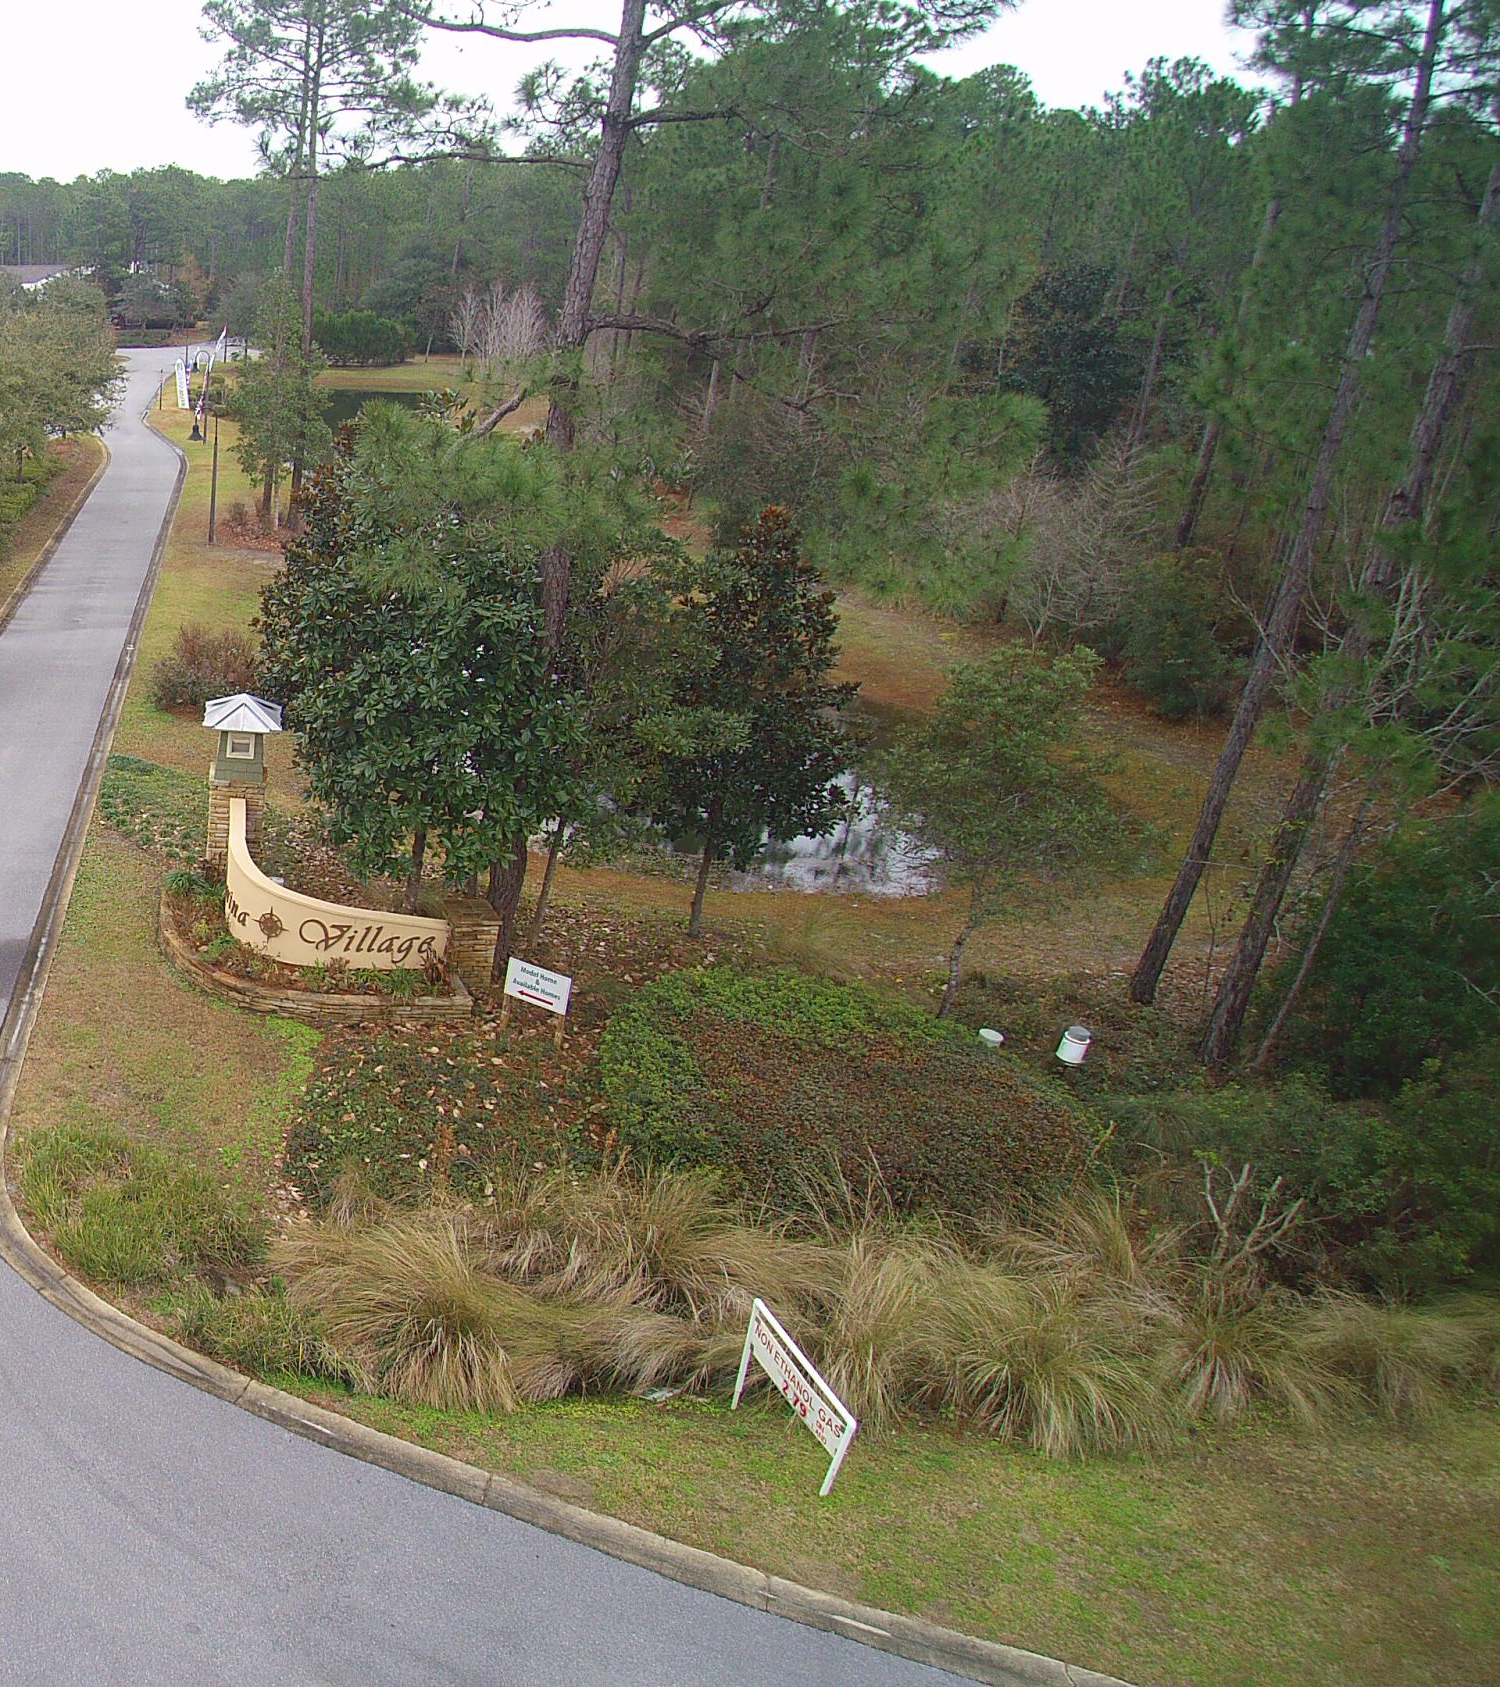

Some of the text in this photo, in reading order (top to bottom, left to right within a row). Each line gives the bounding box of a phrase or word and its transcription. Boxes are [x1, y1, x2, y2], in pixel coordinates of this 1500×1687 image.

[298, 918, 437, 964] Village
[512, 978, 561, 1000] Available Homes
[520, 966, 558, 985] Model Home
[754, 1323, 841, 1438] NON ETHANOL GAS
